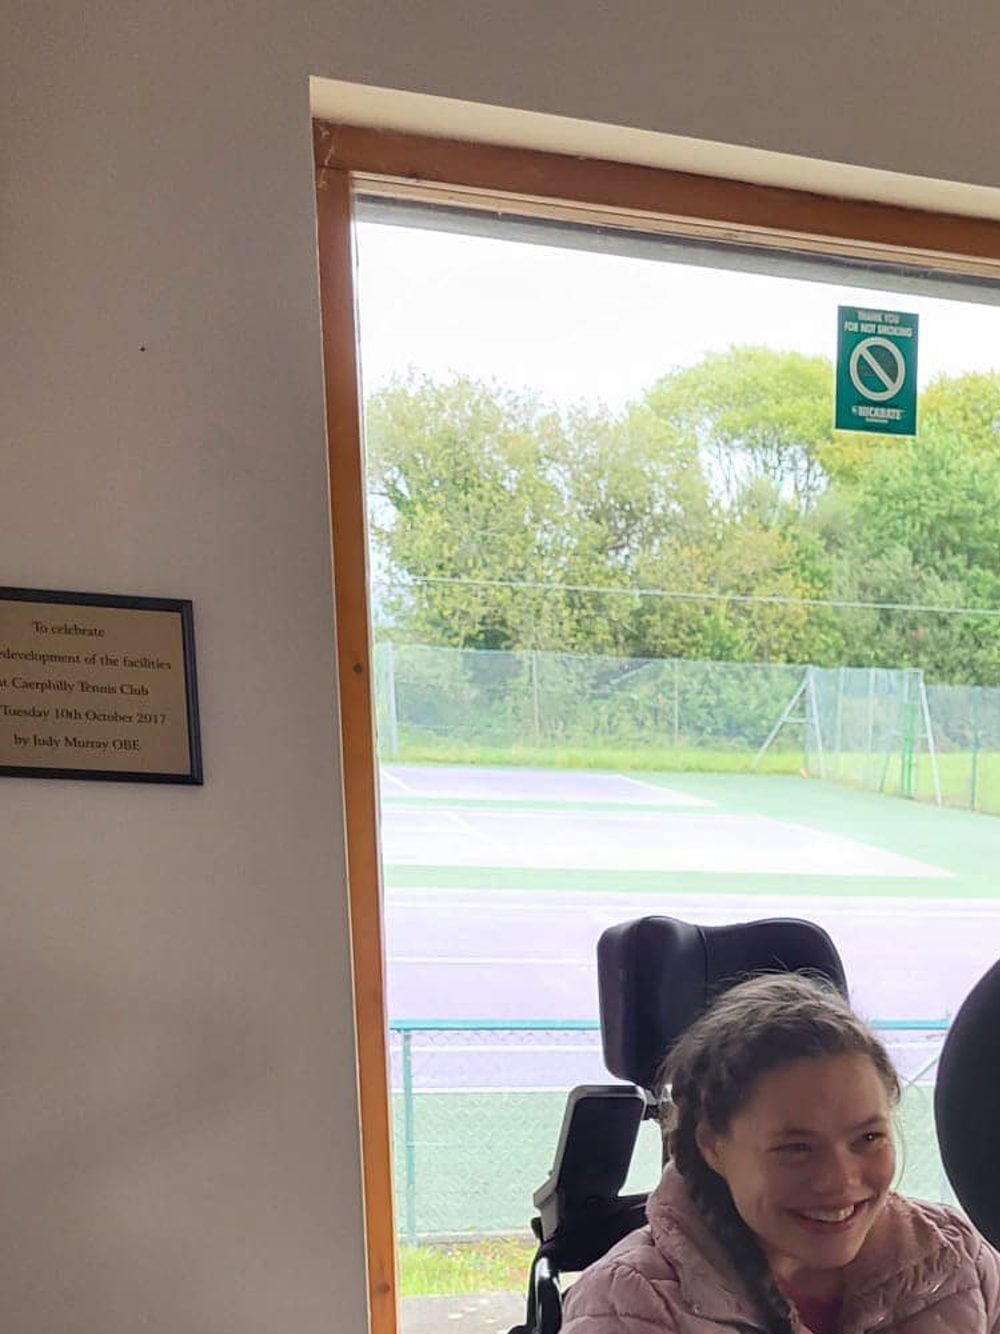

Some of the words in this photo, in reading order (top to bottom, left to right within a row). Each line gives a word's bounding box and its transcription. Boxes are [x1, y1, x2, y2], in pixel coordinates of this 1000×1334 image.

[844, 320, 859, 332] FOR
[860, 322, 876, 333] NOT
[877, 324, 913, 338] SMOKING
[33, 621, 48, 634] To
[51, 623, 105, 638] celebrate
[84, 652, 98, 666] of
[100, 653, 120, 667] the
[123, 655, 171, 670] facilities
[11, 676, 75, 694] Caerphilly
[79, 680, 117, 695] Tennis
[120, 682, 150, 697] Club
[0, 704, 50, 721] Tuesday
[55, 707, 82, 722] 10th
[85, 710, 133, 724] October
[136, 712, 167, 726] 2017
[14, 732, 29, 747] by
[33, 734, 61, 749] Judy
[64, 736, 109, 752] Murray
[112, 739, 140, 752] OBE
